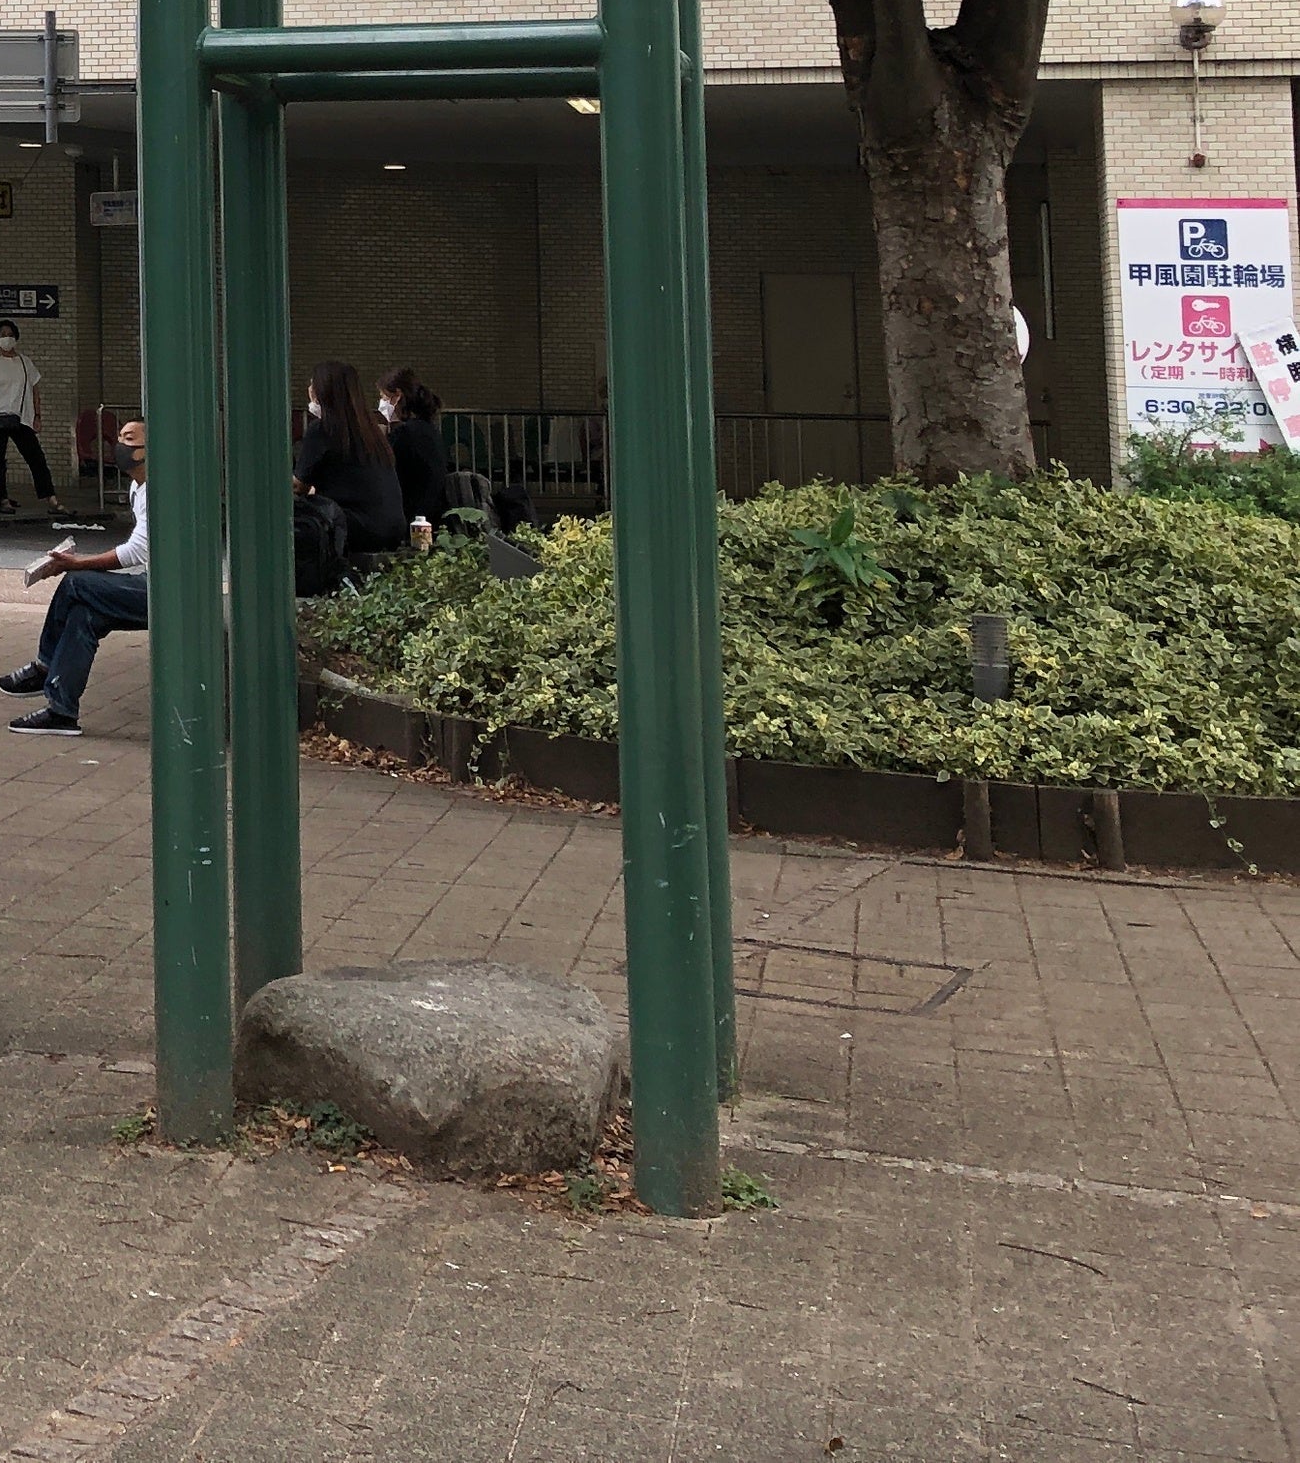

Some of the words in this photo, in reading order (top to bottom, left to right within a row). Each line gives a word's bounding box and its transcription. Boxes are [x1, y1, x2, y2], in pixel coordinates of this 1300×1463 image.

[1128, 264, 1286, 288] 甲風園駐輪場
[1140, 365, 1254, 382] （定期・一時利
